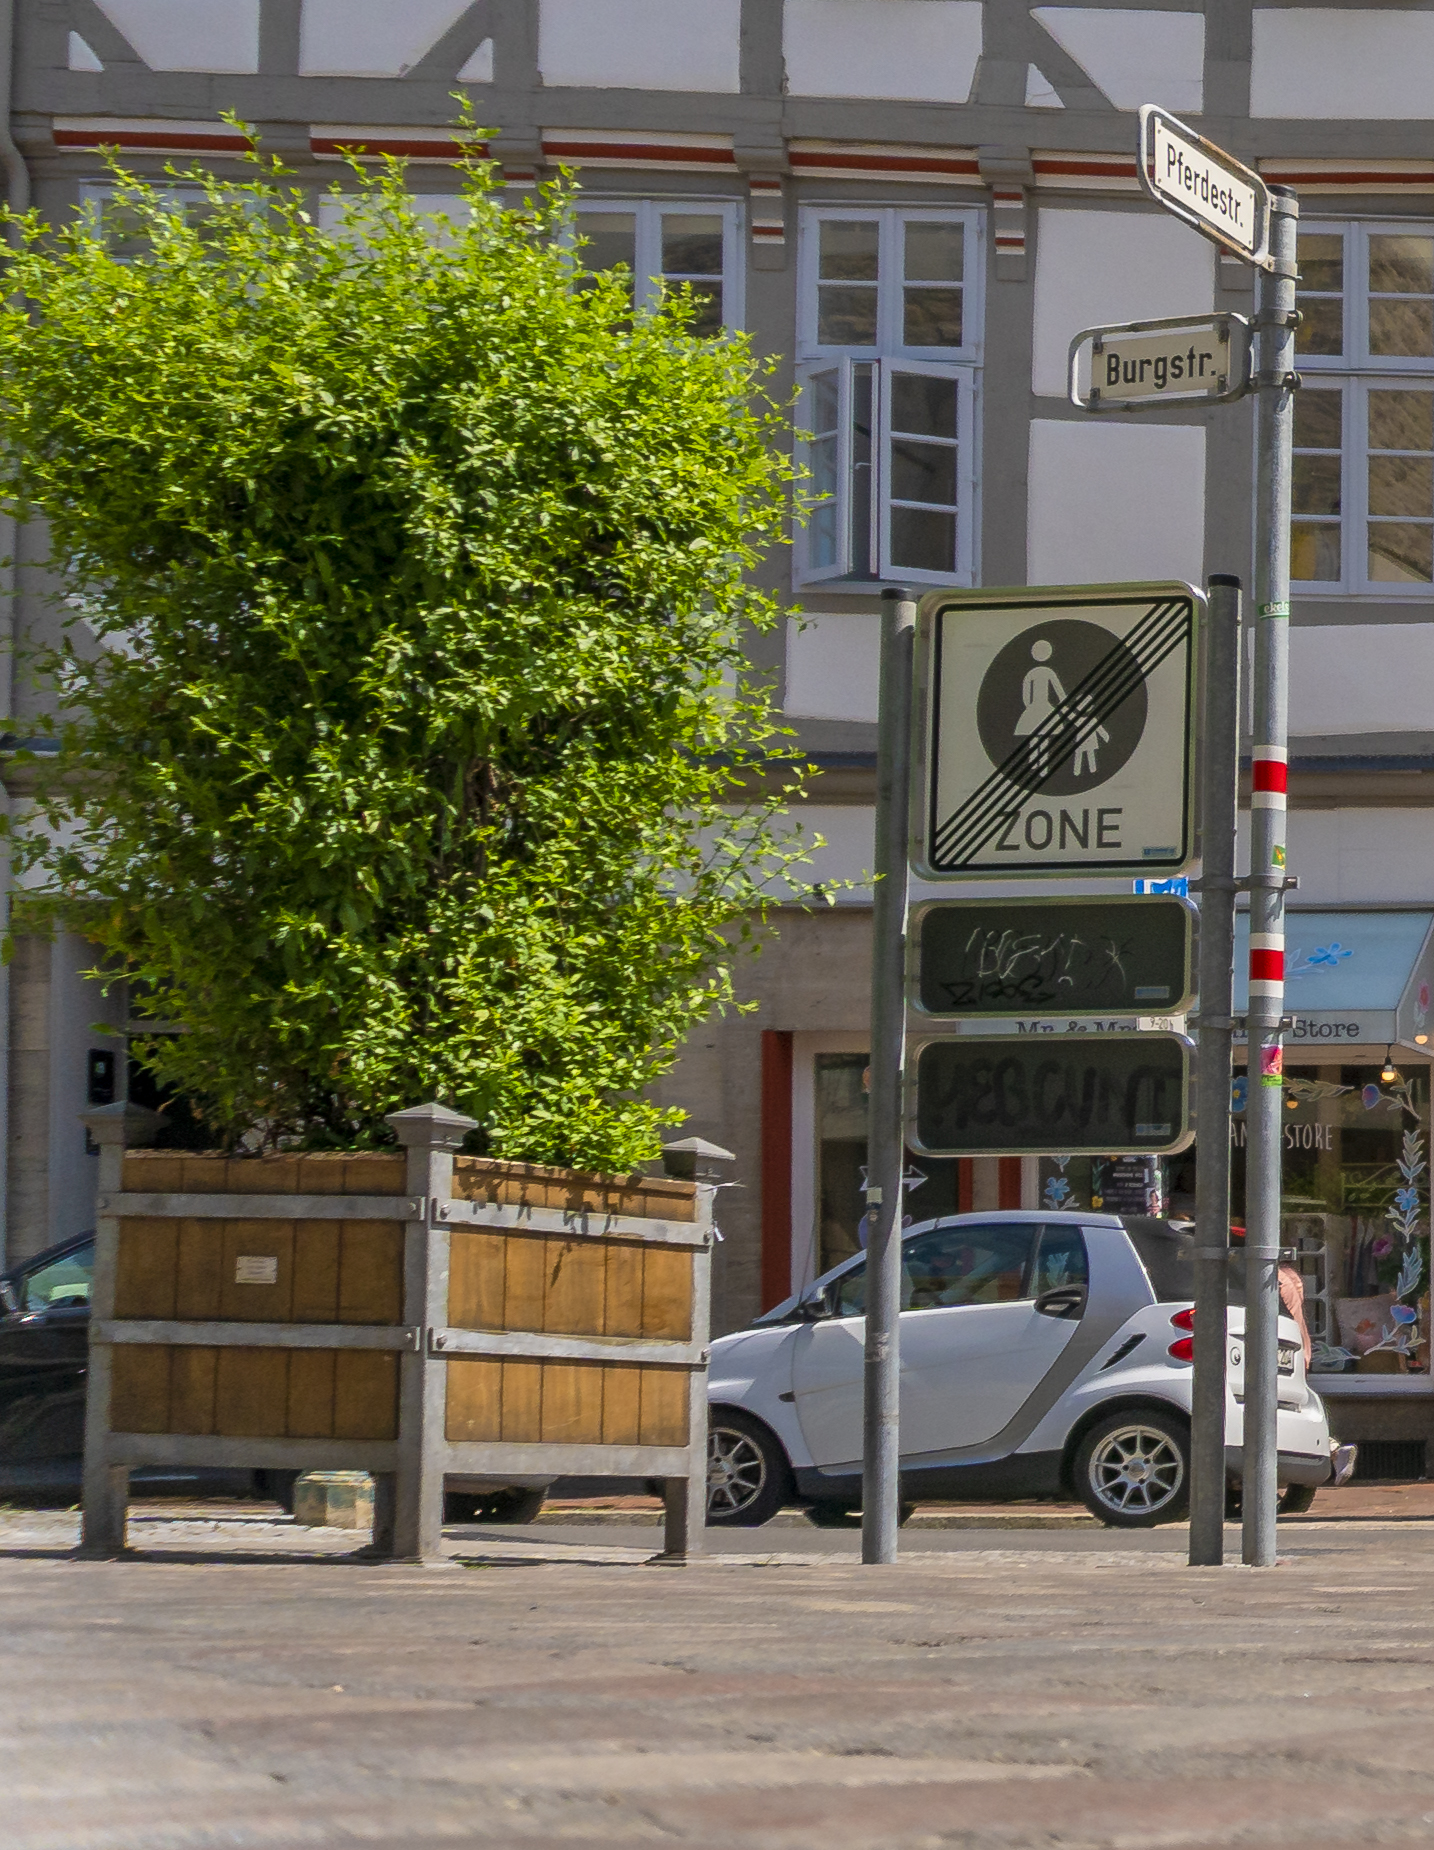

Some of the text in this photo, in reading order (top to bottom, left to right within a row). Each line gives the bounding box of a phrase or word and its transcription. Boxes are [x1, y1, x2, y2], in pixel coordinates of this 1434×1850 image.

[1166, 141, 1244, 228] Pferdestr.
[1106, 345, 1217, 389] Burgstr.
[995, 807, 1122, 851] ZONE
